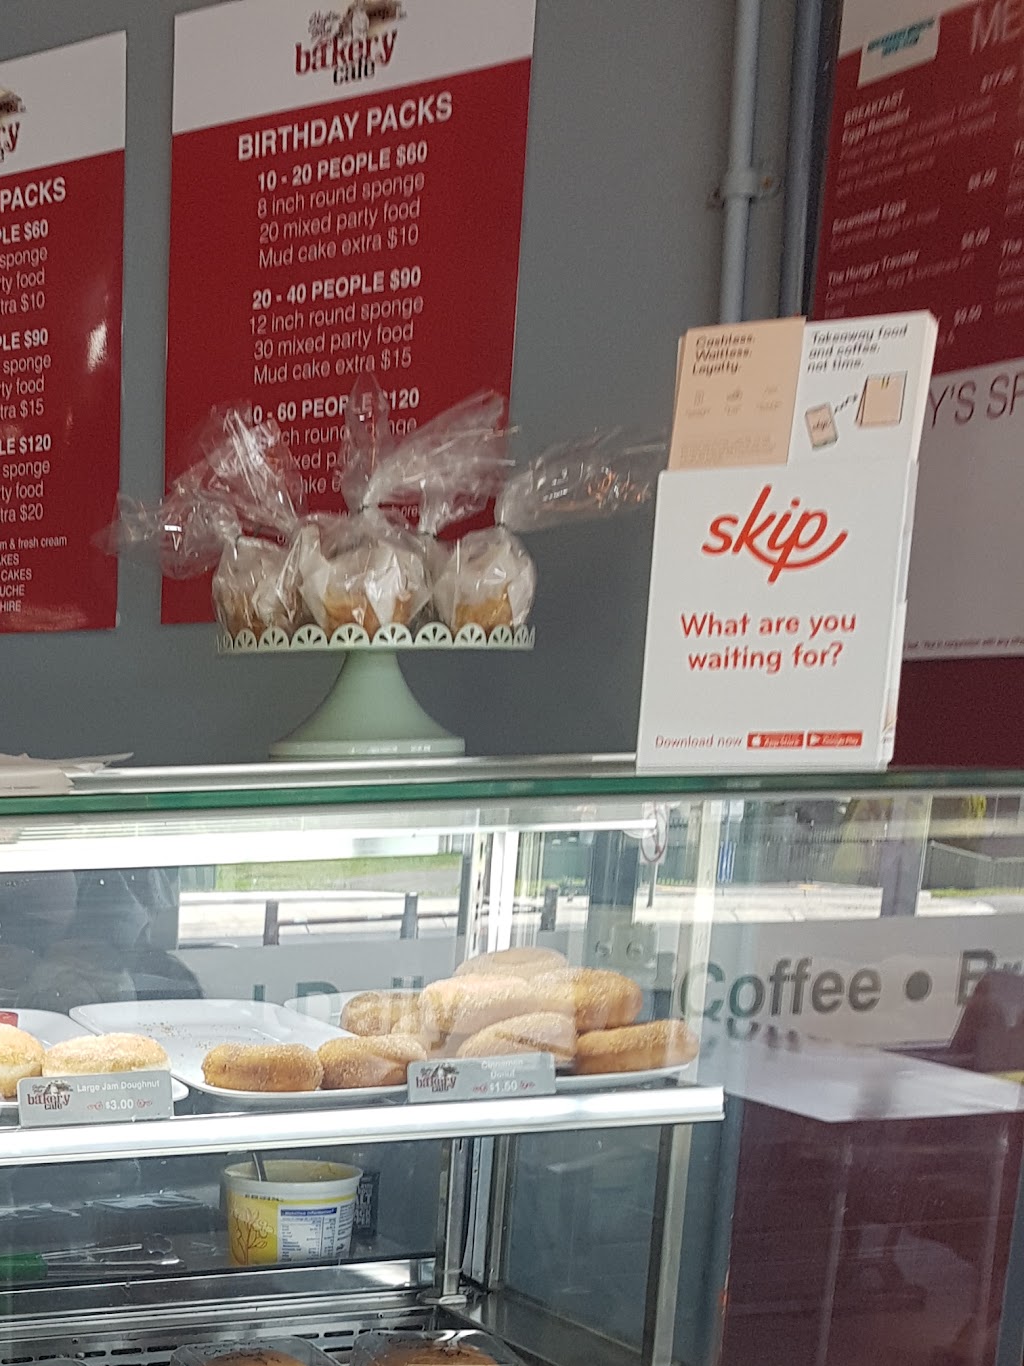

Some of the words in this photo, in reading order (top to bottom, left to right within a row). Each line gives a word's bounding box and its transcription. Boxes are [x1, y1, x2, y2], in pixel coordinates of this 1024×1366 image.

[238, 112, 360, 162] BIRTHDAY
[366, 91, 454, 135] PACKS
[258, 170, 277, 193] 10
[292, 164, 312, 187] 20
[317, 147, 391, 182] PEOPLE
[396, 140, 428, 167] $60
[0, 176, 67, 211] PACKS
[258, 198, 268, 219] 8
[271, 190, 305, 215] inch
[309, 182, 357, 209] round
[361, 172, 425, 203] sponge
[23, 219, 49, 241] $60
[259, 222, 279, 245] 20
[283, 213, 332, 239] mixed
[336, 206, 378, 235] party
[382, 198, 421, 222] food
[0, 246, 48, 270] sponge
[258, 245, 295, 269] Mud
[298, 239, 337, 262] cake
[341, 233, 382, 257] extra
[386, 226, 420, 250] $10
[16, 268, 45, 289] food
[252, 289, 272, 311] 20
[286, 283, 307, 305] 40
[312, 271, 385, 301] PEOPLE
[389, 265, 422, 290] $90
[20, 291, 45, 313] $10
[249, 315, 268, 336] 12
[271, 309, 304, 333] inch
[308, 302, 356, 328] round
[361, 295, 424, 323] sponge
[23, 328, 49, 350] $90
[254, 340, 274, 361] 30
[278, 332, 325, 357] mixed
[330, 329, 371, 354] party
[376, 320, 414, 343] food
[811, 326, 875, 348] Takeaway
[878, 323, 908, 340] food
[808, 342, 833, 359] and
[3, 353, 52, 377] sponge
[254, 363, 289, 385] Mud
[292, 357, 331, 381] cake
[335, 353, 375, 377] extra
[380, 347, 412, 371] $15
[806, 358, 828, 373] not
[16, 375, 45, 393] food
[19, 398, 44, 418] $15
[277, 401, 297, 422] 60
[19, 433, 52, 454] $120
[2, 458, 51, 480] sponge
[16, 480, 44, 498] food
[19, 502, 44, 522] $20
[18, 537, 39, 550] fresh
[40, 535, 68, 548] cream
[701, 483, 849, 585] skip
[1, 568, 32, 582] CAKES
[0, 600, 22, 613] HIRE
[680, 613, 750, 639] What
[759, 617, 800, 636] are
[809, 613, 857, 639] you
[688, 646, 782, 675] waiting
[792, 643, 843, 669] for?
[655, 734, 714, 749] Download
[717, 737, 743, 748] now
[680, 957, 882, 1021] Coffee
[76, 1083, 101, 1095] Large
[101, 1082, 119, 1092] Jam
[121, 1079, 160, 1091] Doughnut
[27, 1092, 71, 1106] bakery
[105, 1099, 134, 1111] $3.00
